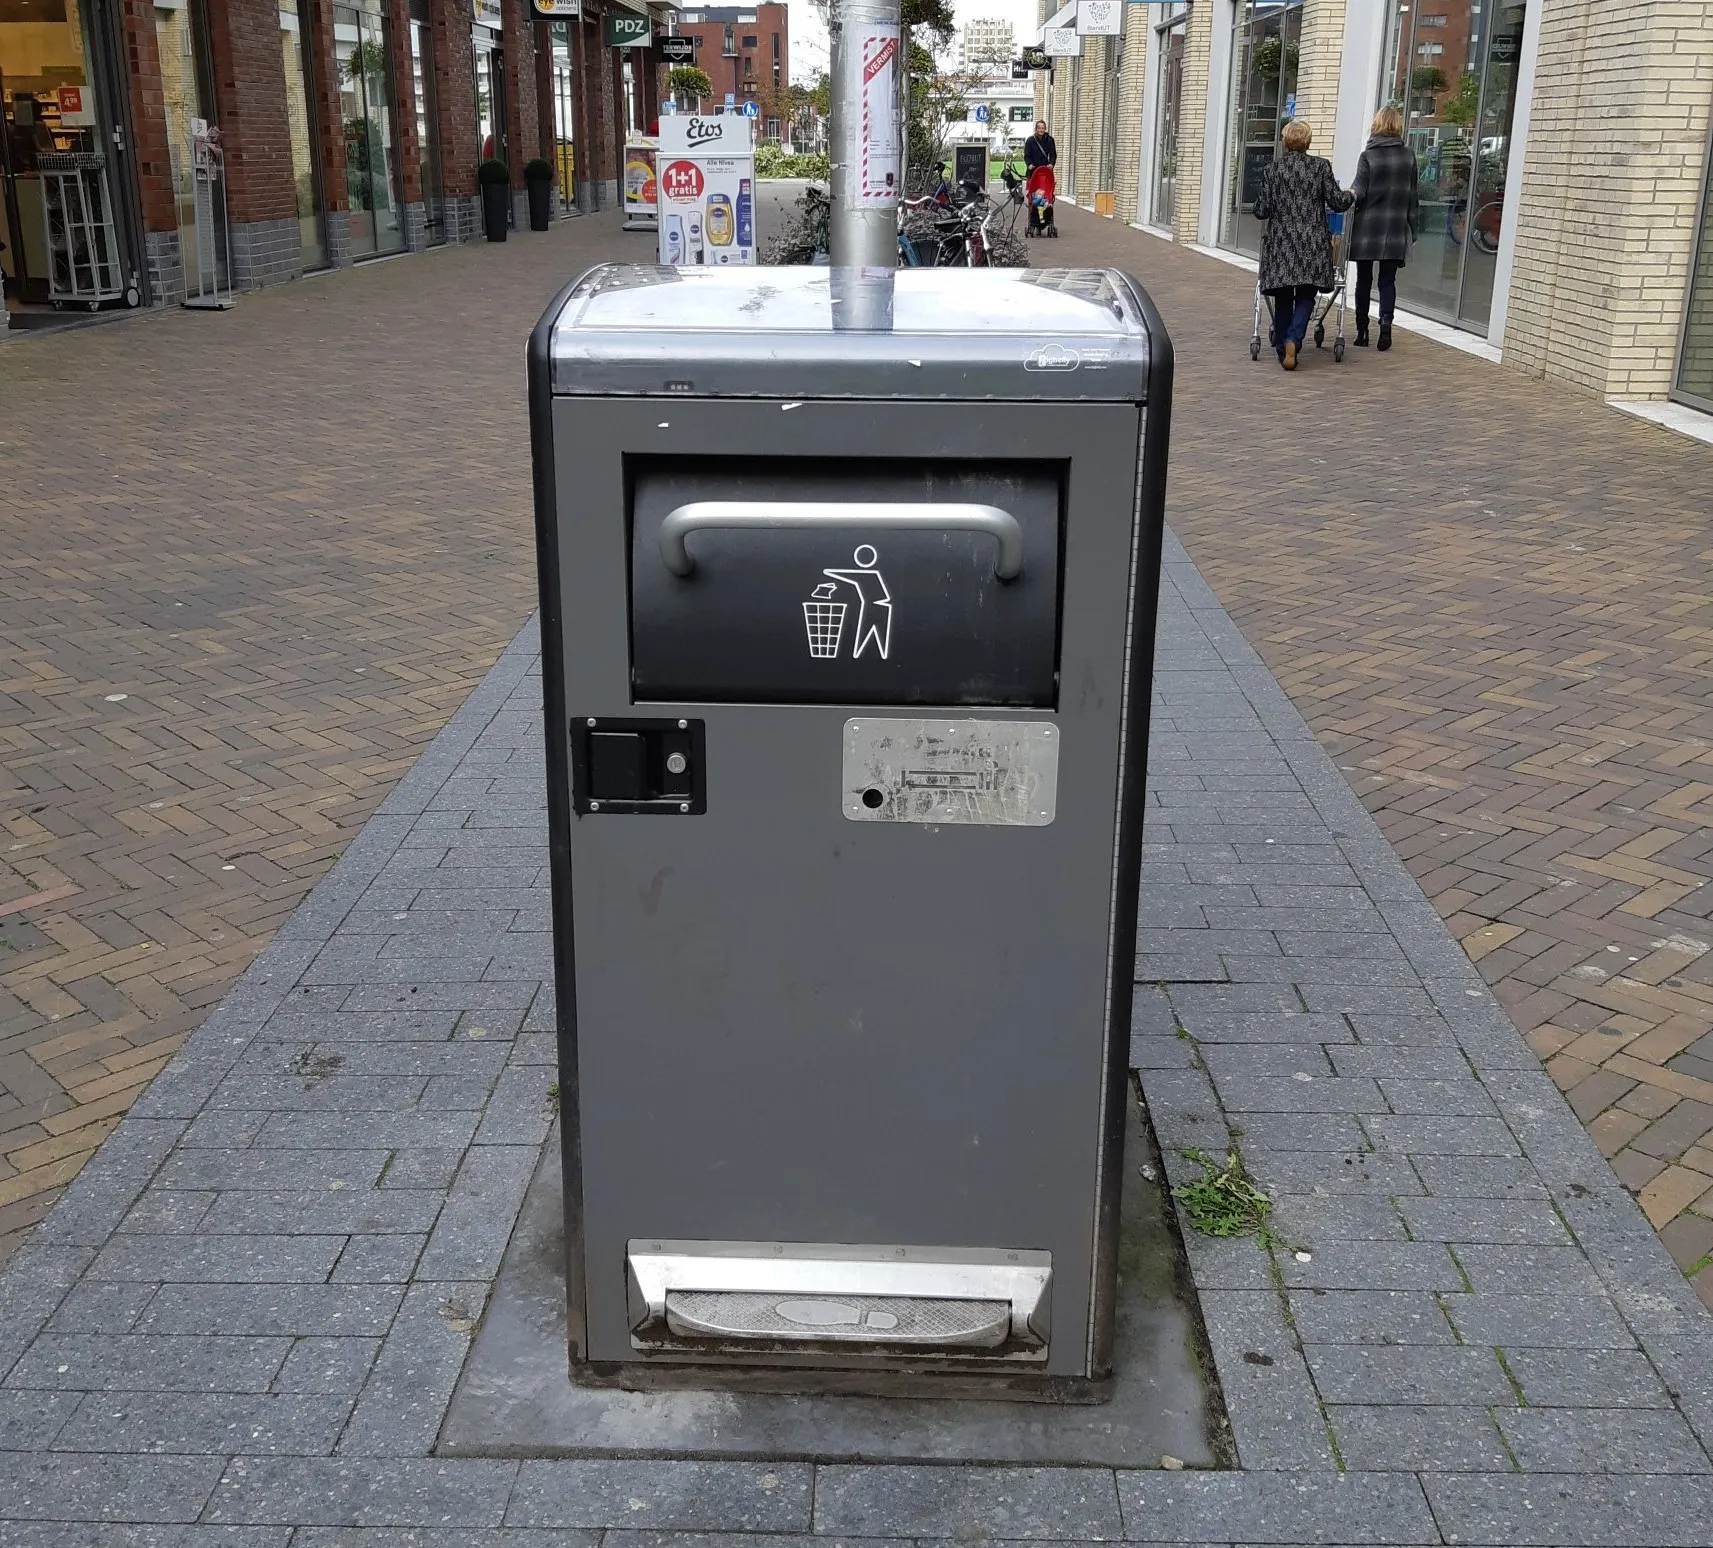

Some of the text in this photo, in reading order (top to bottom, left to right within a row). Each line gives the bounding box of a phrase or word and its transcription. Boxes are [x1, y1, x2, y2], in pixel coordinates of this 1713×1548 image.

[615, 19, 645, 33] PDZ
[867, 41, 896, 74] VERMIST
[686, 117, 723, 139] Etos
[668, 168, 697, 186] 1+1
[669, 185, 698, 197] gratis
